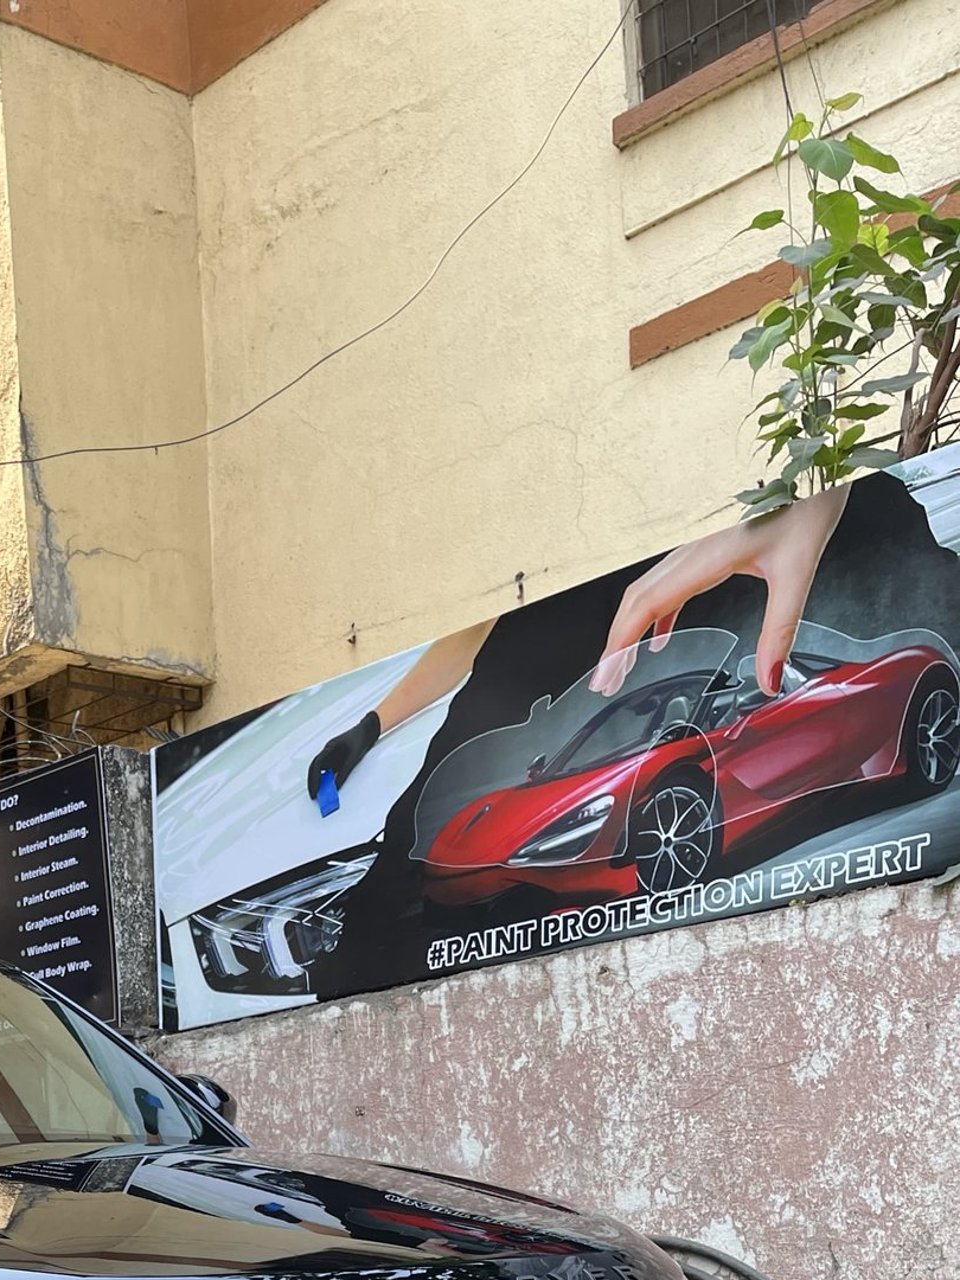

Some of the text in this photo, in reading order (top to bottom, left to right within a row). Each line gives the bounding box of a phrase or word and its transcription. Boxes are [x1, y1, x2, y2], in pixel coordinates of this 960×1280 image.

[0, 794, 19, 811] DO?
[15, 800, 87, 831] Decontamination.
[18, 826, 89, 856] Interior Detailing.
[20, 857, 79, 881] Interior Steam.
[22, 880, 89, 906] Paint Correction.
[427, 833, 932, 970] #PAINT PROTECTION EXPERT
[25, 904, 100, 931] Graphene Coating.
[26, 936, 81, 957] Window Film.
[45, 965, 66, 977] Body
[66, 960, 92, 972] Wrap.
